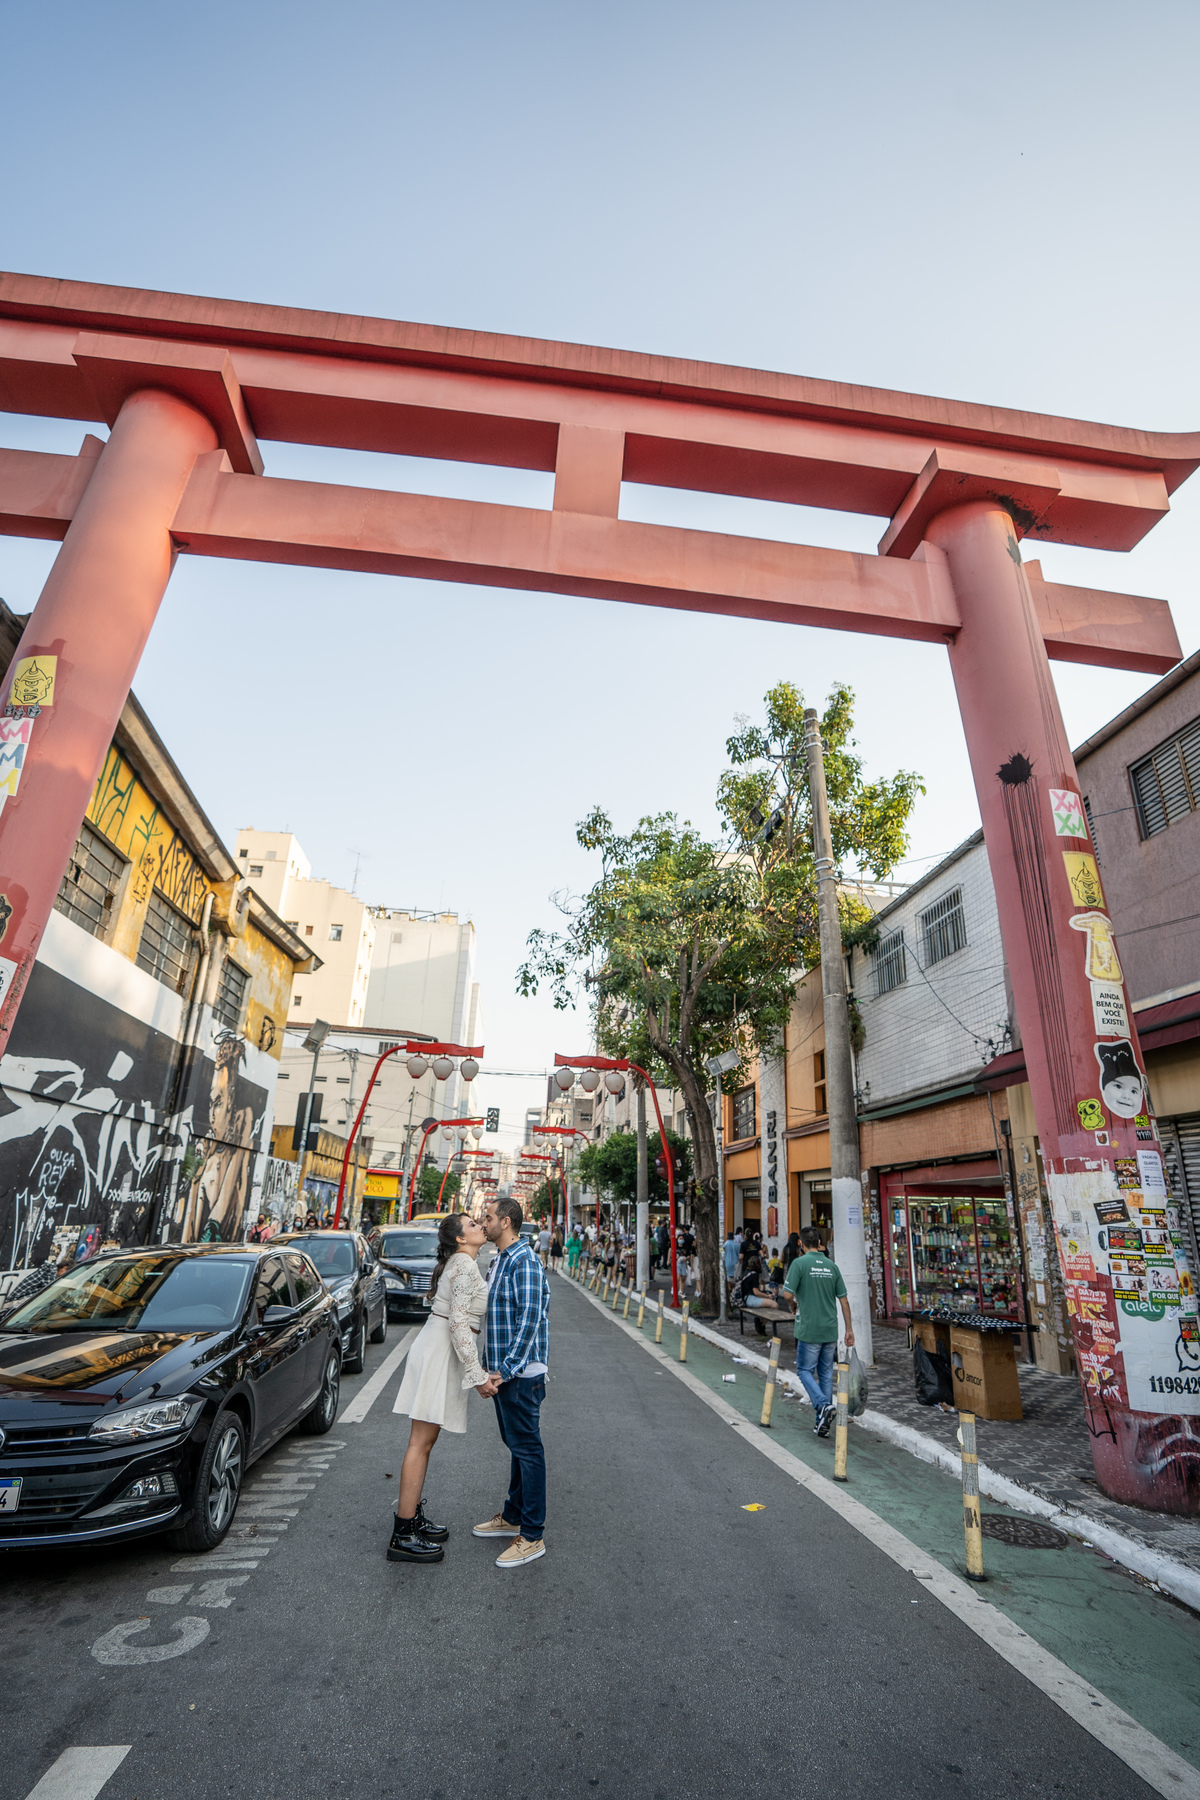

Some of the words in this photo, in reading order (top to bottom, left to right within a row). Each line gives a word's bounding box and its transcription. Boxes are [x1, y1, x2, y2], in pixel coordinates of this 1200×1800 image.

[1100, 992, 1120, 1000] AINDA
[50, 1148, 75, 1167] OUÇA
[767, 1110, 778, 1204] BANRI
[966, 1374, 982, 1386] amcor
